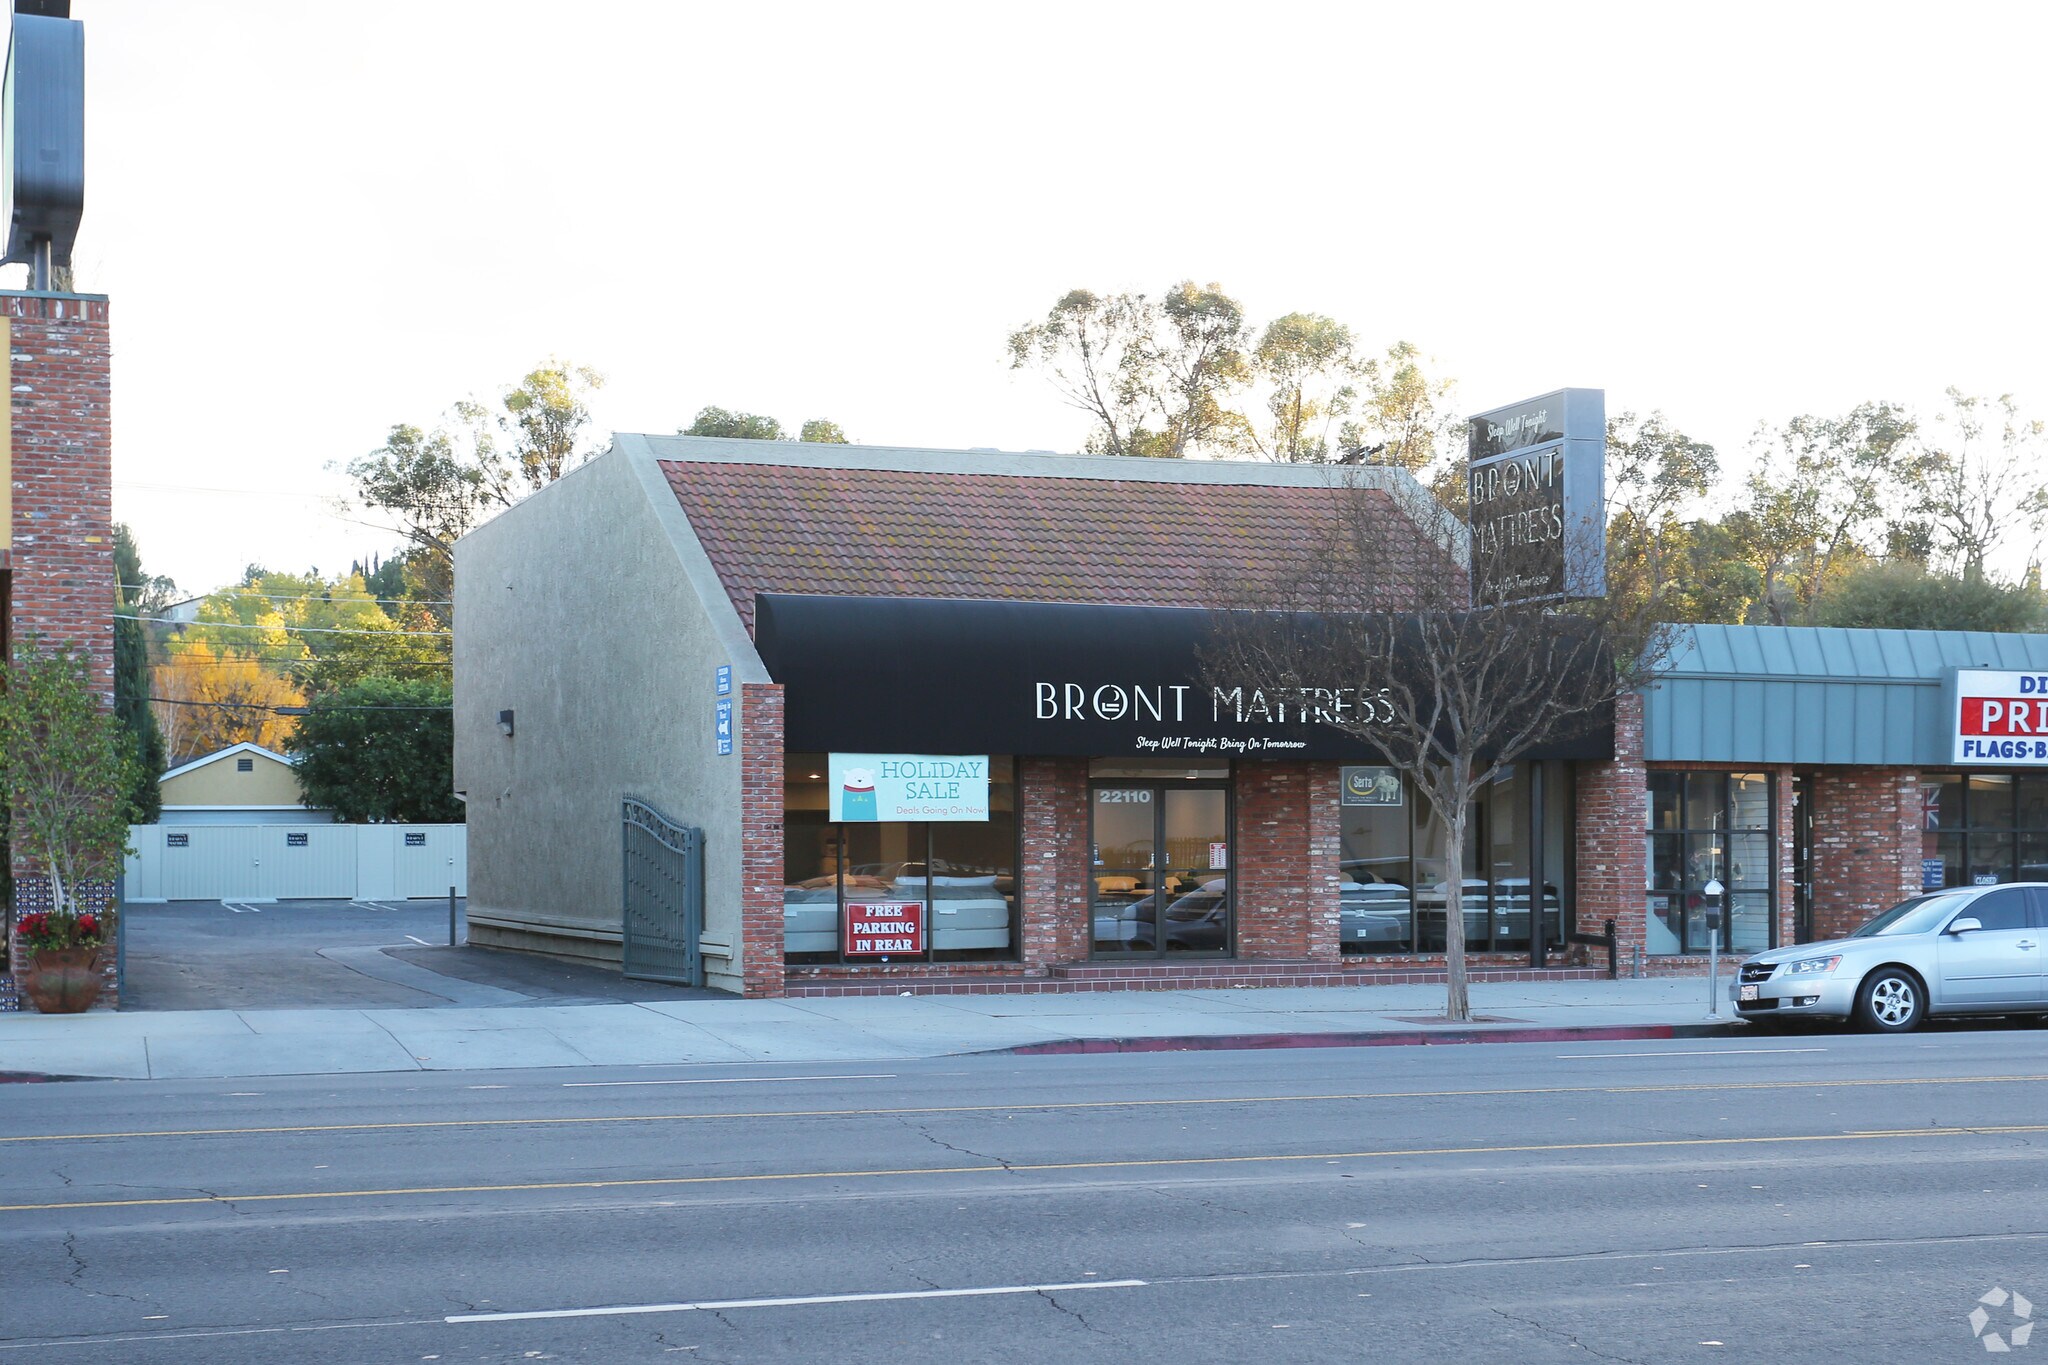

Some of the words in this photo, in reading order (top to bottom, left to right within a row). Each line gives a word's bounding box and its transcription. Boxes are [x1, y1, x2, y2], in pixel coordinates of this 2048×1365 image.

[1487, 423, 1504, 442] Sleep
[1505, 417, 1520, 436] Well
[1521, 409, 1547, 433] Tonight
[1474, 452, 1557, 505] BRONT
[1036, 682, 1190, 722] BRONT
[1213, 686, 1395, 723] MATTRESS
[1136, 736, 1160, 751] Sleep
[1161, 736, 1181, 749] Well
[1220, 737, 1247, 753] Bring
[1248, 737, 1261, 750] On
[1263, 738, 1307, 749] Tomorrow
[881, 761, 982, 779] HOLIDAY
[1354, 776, 1373, 788] Serta
[906, 782, 960, 800] SALE
[1100, 791, 1150, 803] 22110
[896, 806, 920, 815] Deals
[922, 806, 947, 816] Going
[950, 806, 963, 814] On
[865, 905, 902, 917] FREE
[853, 922, 915, 934] PARKING
[856, 940, 871, 951] IN
[875, 939, 912, 951] REAR
